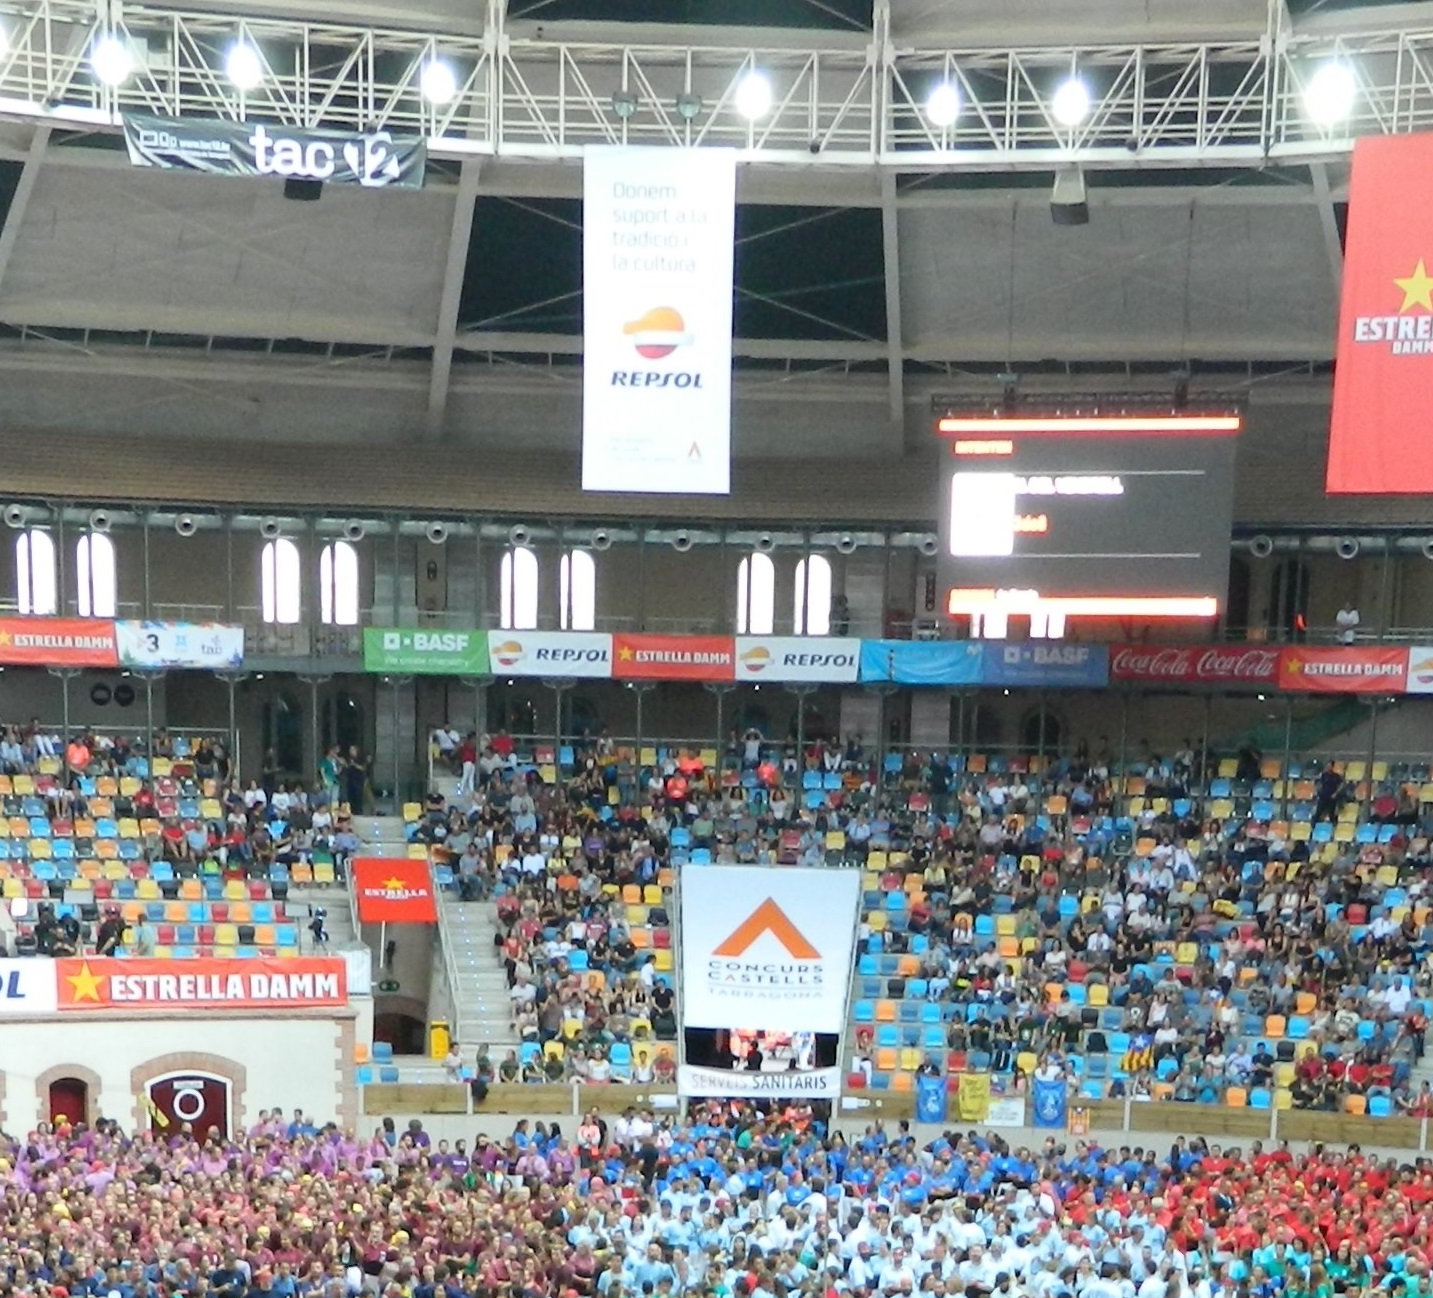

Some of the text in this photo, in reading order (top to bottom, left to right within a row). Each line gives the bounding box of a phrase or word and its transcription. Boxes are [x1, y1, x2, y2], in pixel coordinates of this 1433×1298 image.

[249, 124, 335, 178] tac
[610, 370, 703, 389] REPSOL
[14, 635, 114, 651] ESTRELLA DAMM
[146, 633, 160, 654] 3
[414, 634, 468, 651] BASF
[536, 648, 608, 664] REPSOL
[635, 651, 731, 666] ESTRELLA DAMM
[783, 653, 856, 669] REPSOL
[1033, 648, 1088, 665] BASF
[1304, 662, 1403, 677] ESTRELLA DAMM
[708, 960, 824, 973] CONCURS
[111, 972, 339, 1000] ESTRELLA DAMM
[708, 973, 824, 984] CASTELLS
[691, 1073, 826, 1090] SERVEIS SANITARIS
